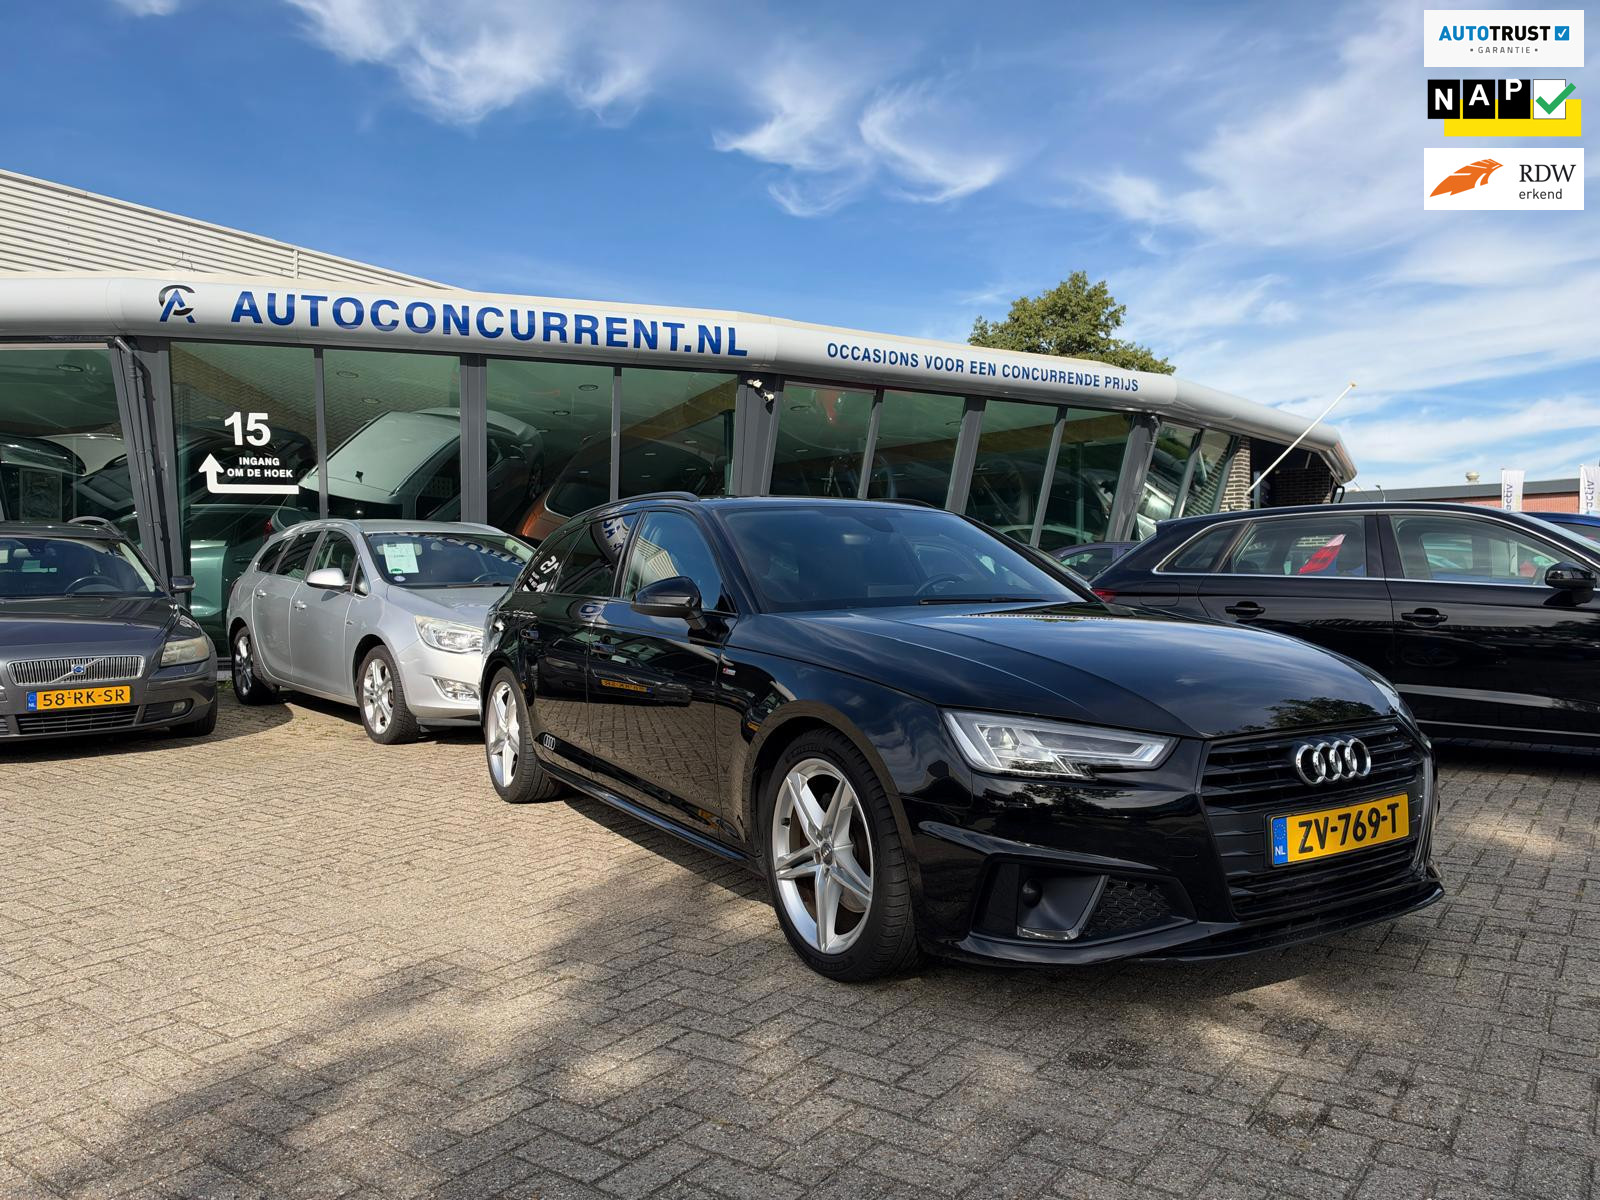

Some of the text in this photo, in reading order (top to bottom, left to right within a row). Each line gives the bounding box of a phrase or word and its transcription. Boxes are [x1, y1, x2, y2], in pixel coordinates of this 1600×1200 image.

[230, 290, 748, 357] AUTOCONCURRENT.NL
[827, 342, 1140, 393] OCCASIONS VOOR EEN CONCURRENDE PRIJS
[224, 411, 271, 447] 15
[226, 468, 294, 478] OM DE HOEK
[238, 456, 280, 466] INGANG
[42, 688, 125, 707] 58-RK-SR
[1274, 802, 1400, 857] NL ZV-769-T
